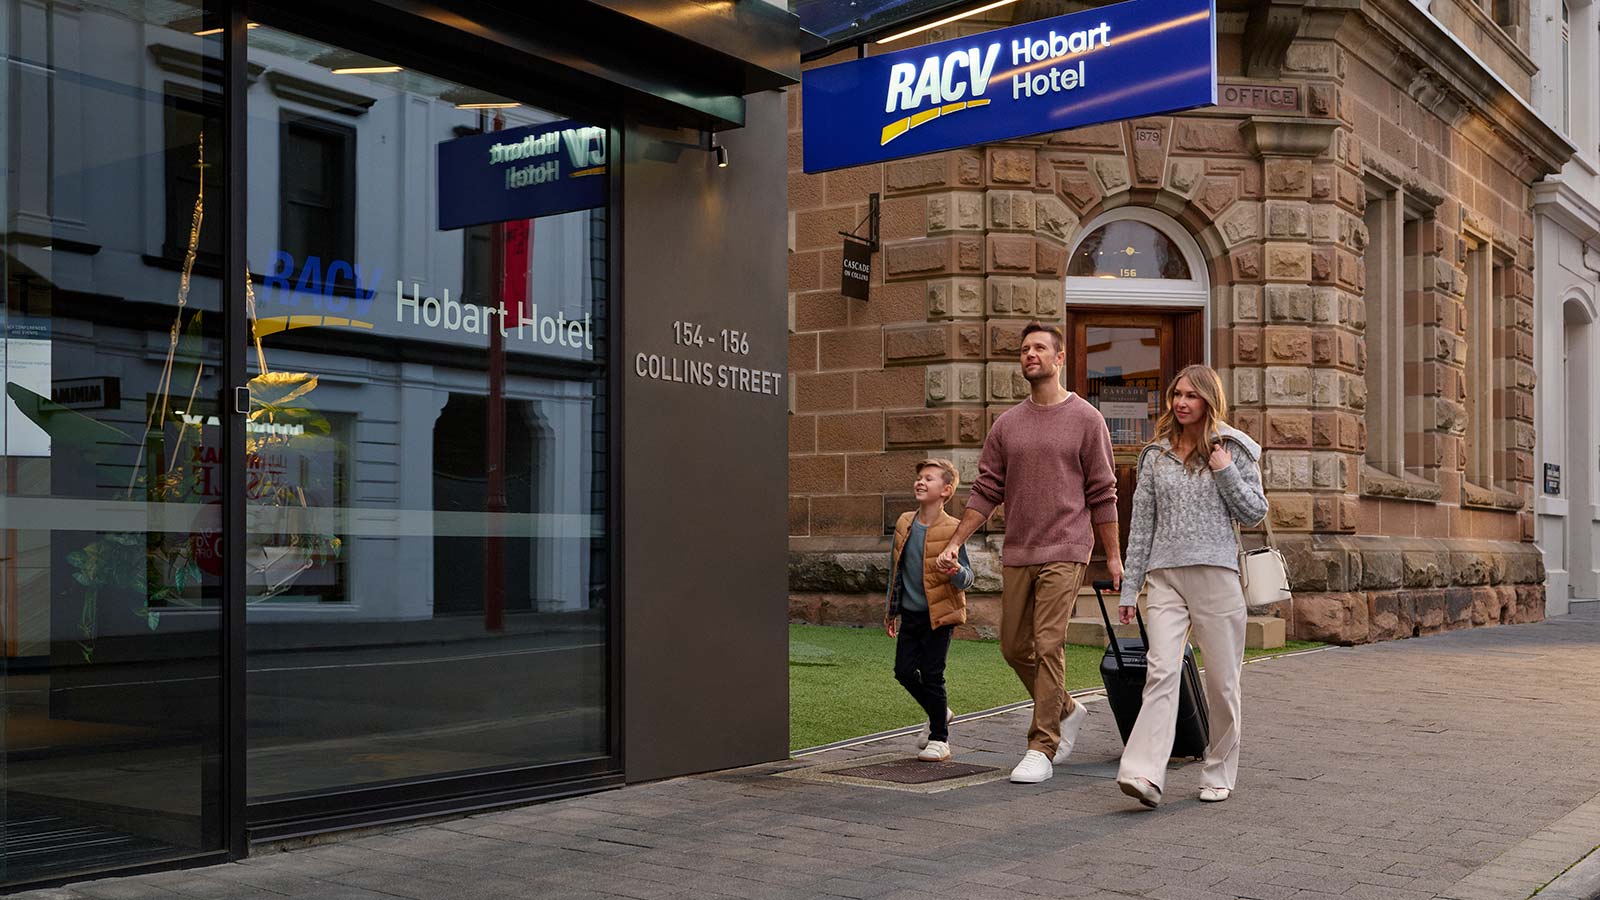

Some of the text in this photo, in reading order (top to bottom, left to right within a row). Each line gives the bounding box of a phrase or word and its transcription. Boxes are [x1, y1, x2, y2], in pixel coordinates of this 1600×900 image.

[1012, 22, 1111, 65] Hobart
[885, 43, 1001, 113] RACV
[1012, 60, 1086, 100] Hotel
[1225, 87, 1294, 106] OFFICE
[1135, 130, 1160, 142] 1879
[261, 250, 383, 316] RACV
[843, 259, 870, 272] CASCADE
[1120, 268, 1137, 278] 156
[396, 280, 593, 350] Hobart Hotel
[673, 320, 703, 348] 154
[721, 328, 749, 355] 156
[635, 352, 782, 395] COLLINS STREET
